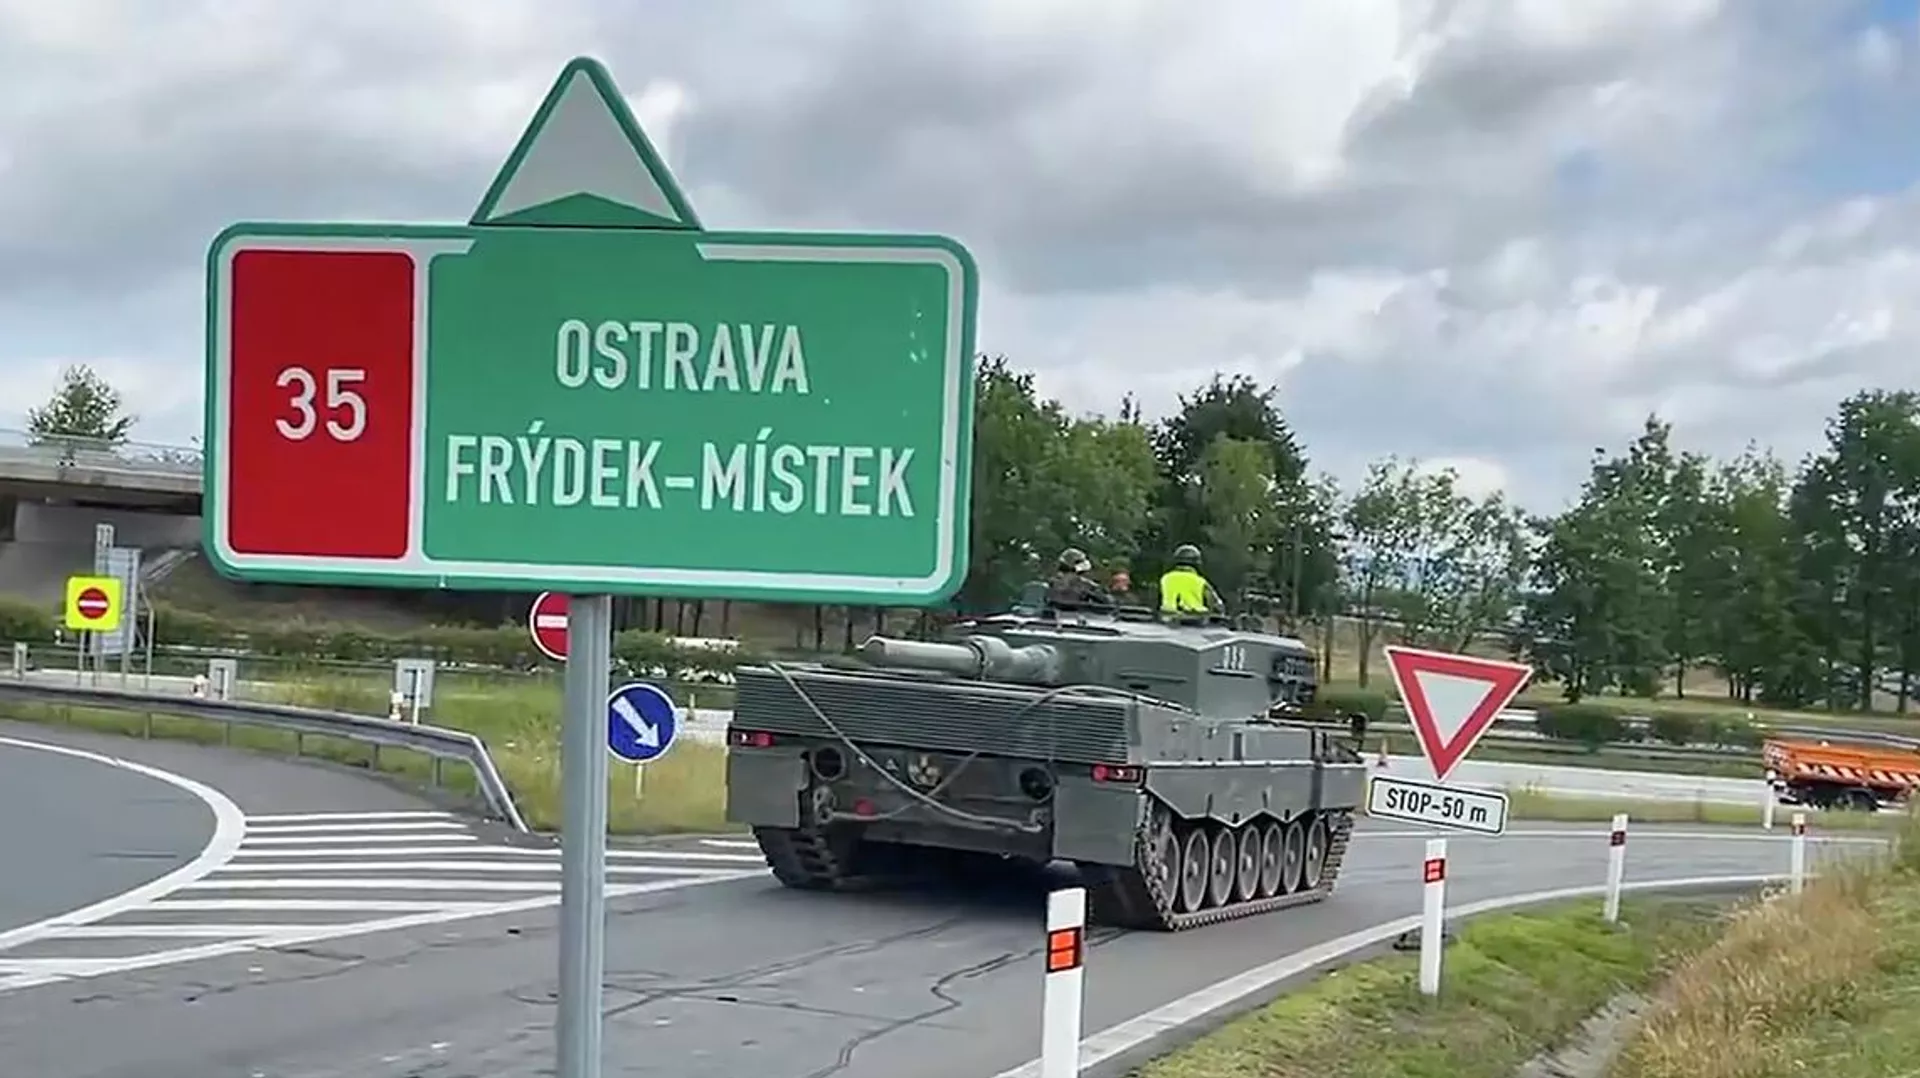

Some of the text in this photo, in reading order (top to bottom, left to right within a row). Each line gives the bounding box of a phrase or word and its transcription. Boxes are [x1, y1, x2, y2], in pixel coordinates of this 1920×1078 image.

[556, 319, 809, 394] OSTRAVA
[275, 367, 366, 441] 35
[446, 420, 915, 517] FRÝDEK-MÍSTEK
[1386, 788, 1487, 822] STOP-50 m
